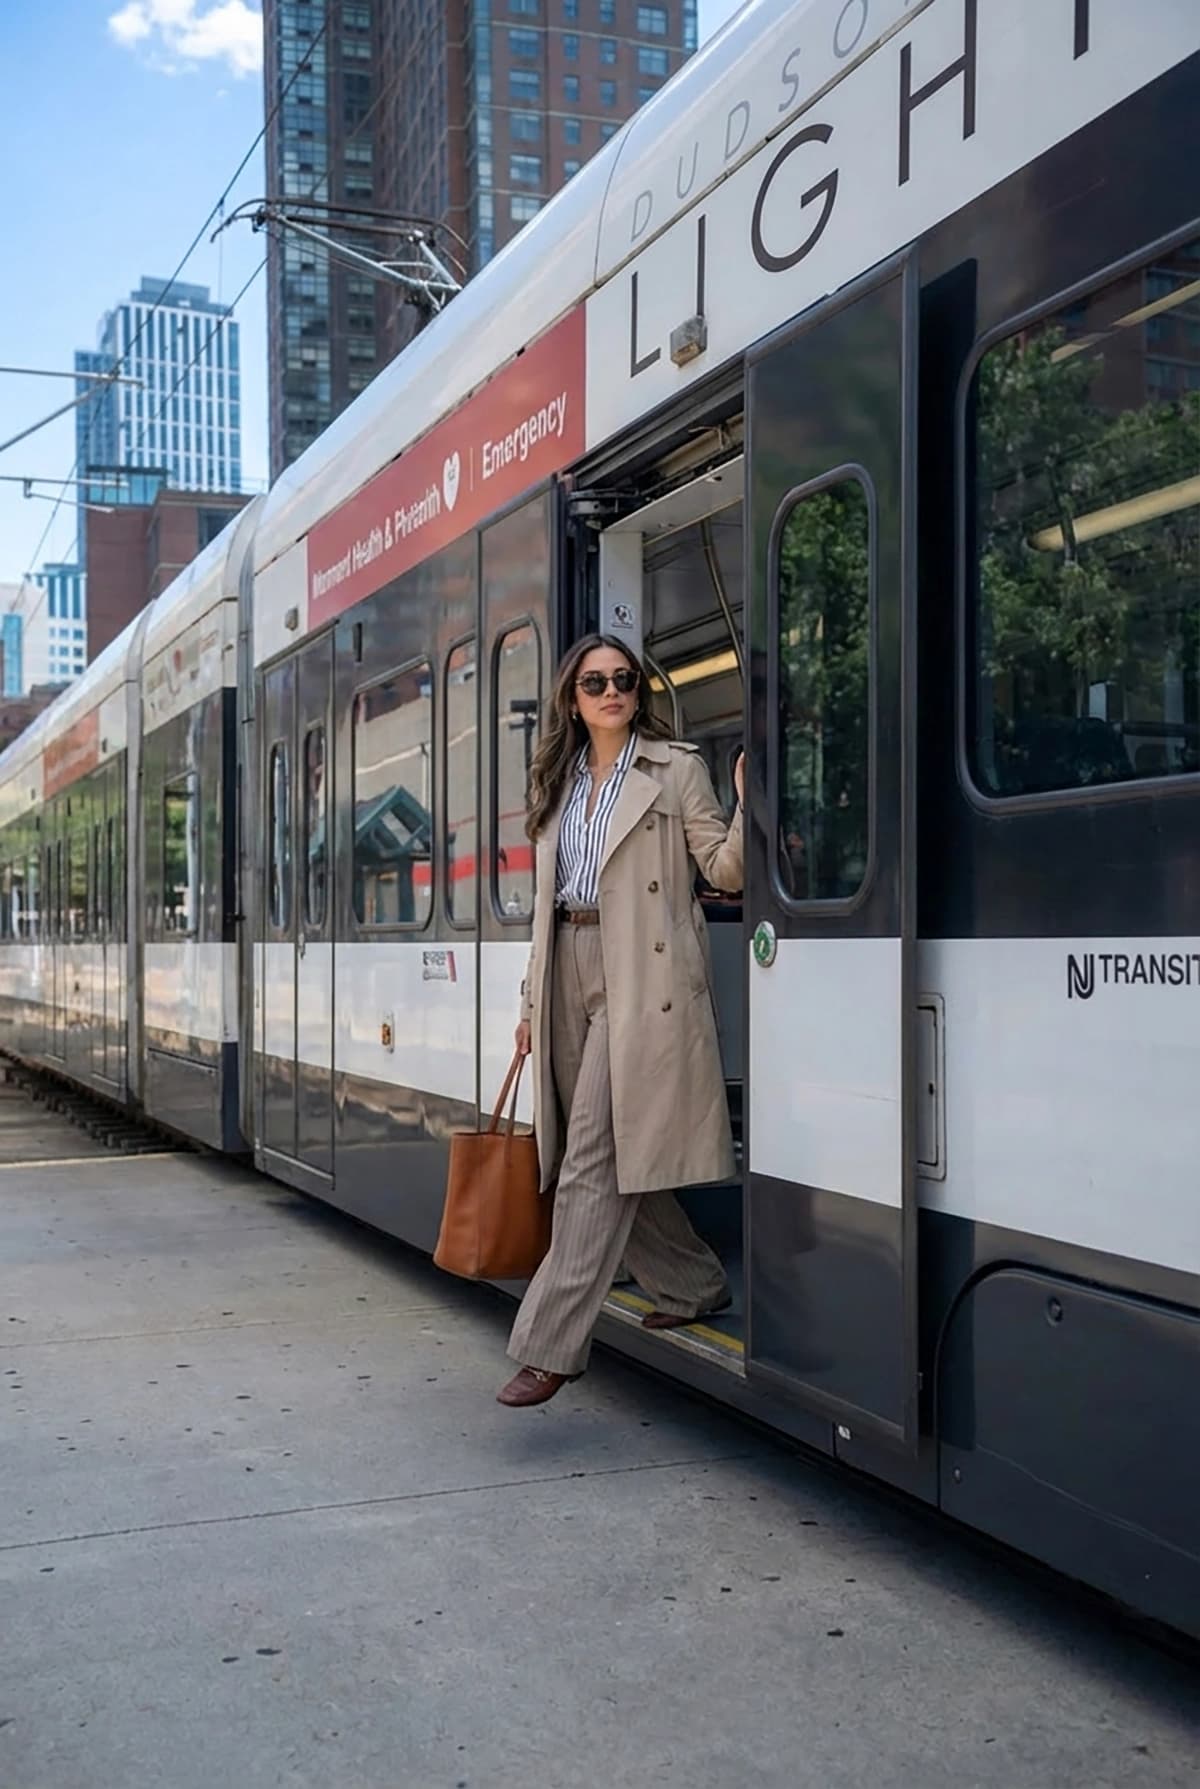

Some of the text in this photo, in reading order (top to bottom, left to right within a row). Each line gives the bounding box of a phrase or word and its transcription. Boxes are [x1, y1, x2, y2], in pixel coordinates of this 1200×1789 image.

[631, 0, 908, 242] DUDSO
[482, 391, 567, 481] Emergency
[1067, 953, 1095, 1000] NJ
